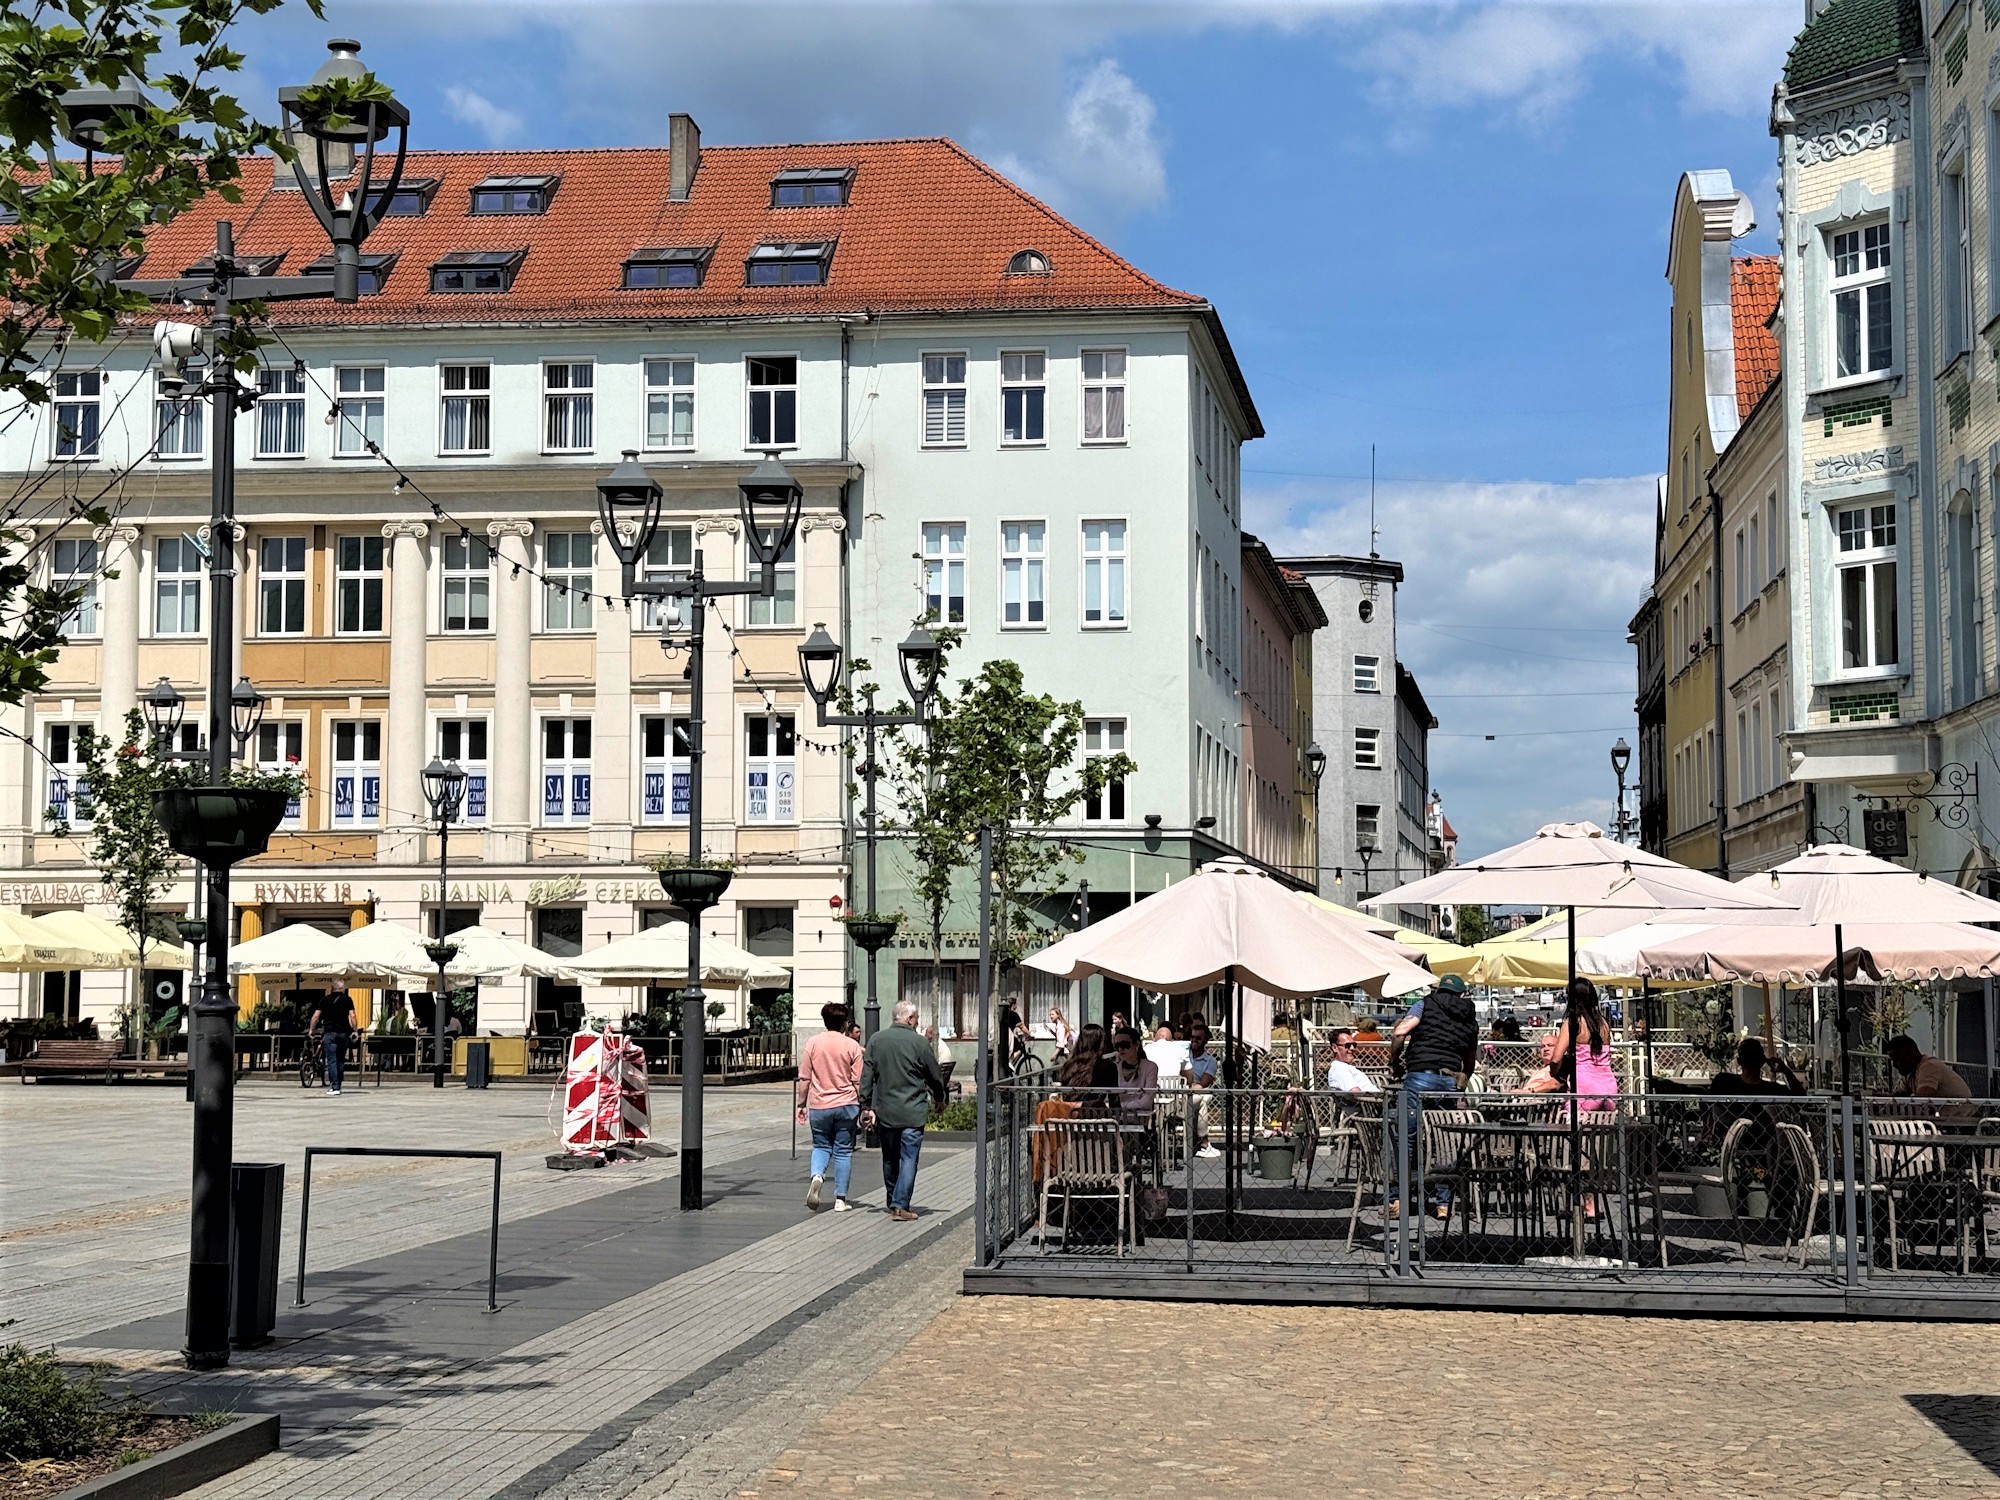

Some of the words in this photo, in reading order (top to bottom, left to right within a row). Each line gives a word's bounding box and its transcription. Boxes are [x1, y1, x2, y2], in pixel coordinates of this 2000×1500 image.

[547, 777, 562, 800] SA
[574, 777, 590, 800] LE
[646, 776, 664, 795] IMP
[754, 773, 763, 786] DO
[337, 779, 352, 802] SA
[364, 779, 379, 802] LE
[645, 796, 664, 813] REZY
[1873, 817, 1897, 833] de
[1873, 833, 1899, 848] sa
[254, 882, 326, 902] RYNEK
[420, 882, 513, 903] PIALNIA
